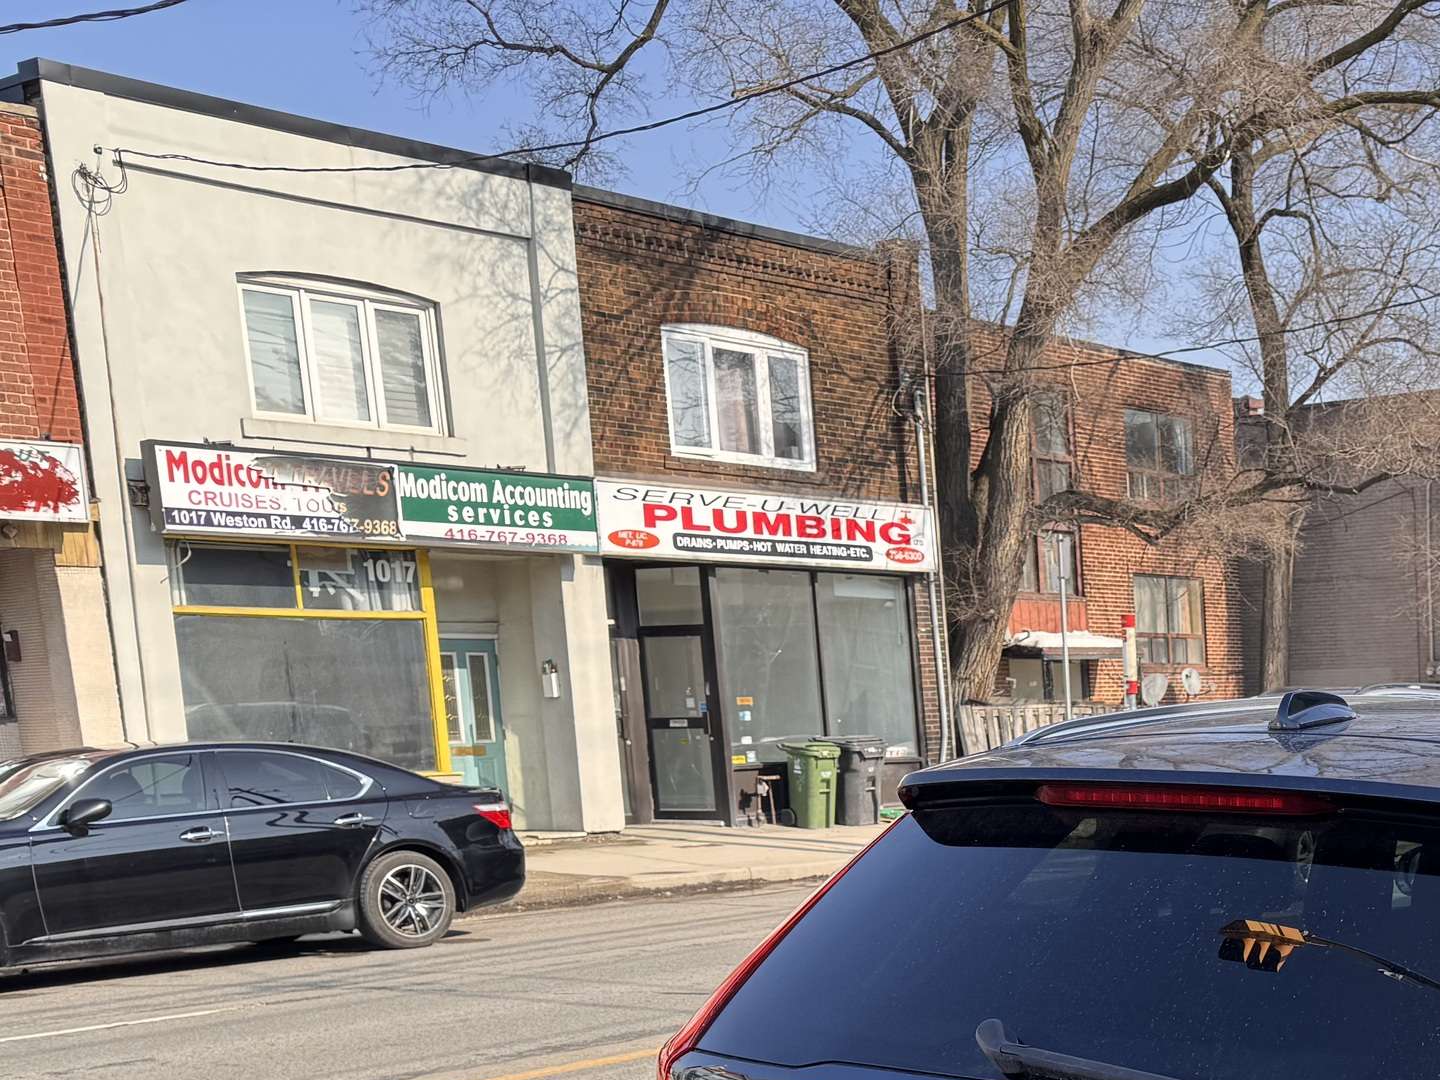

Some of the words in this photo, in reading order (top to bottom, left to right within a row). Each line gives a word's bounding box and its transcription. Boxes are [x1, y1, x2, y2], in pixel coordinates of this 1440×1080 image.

[400, 472, 489, 503] Modicom
[492, 479, 592, 516] Accounting
[612, 487, 887, 521] SERVE-U-WELL
[171, 509, 206, 525] 1017
[211, 511, 268, 528] Weston
[270, 515, 296, 530] Rd.
[447, 504, 553, 528] services
[642, 503, 912, 546] PLUMBING
[444, 528, 568, 546] 416-767-9368
[776, 542, 807, 555] WATER
[363, 558, 416, 583] 1017
